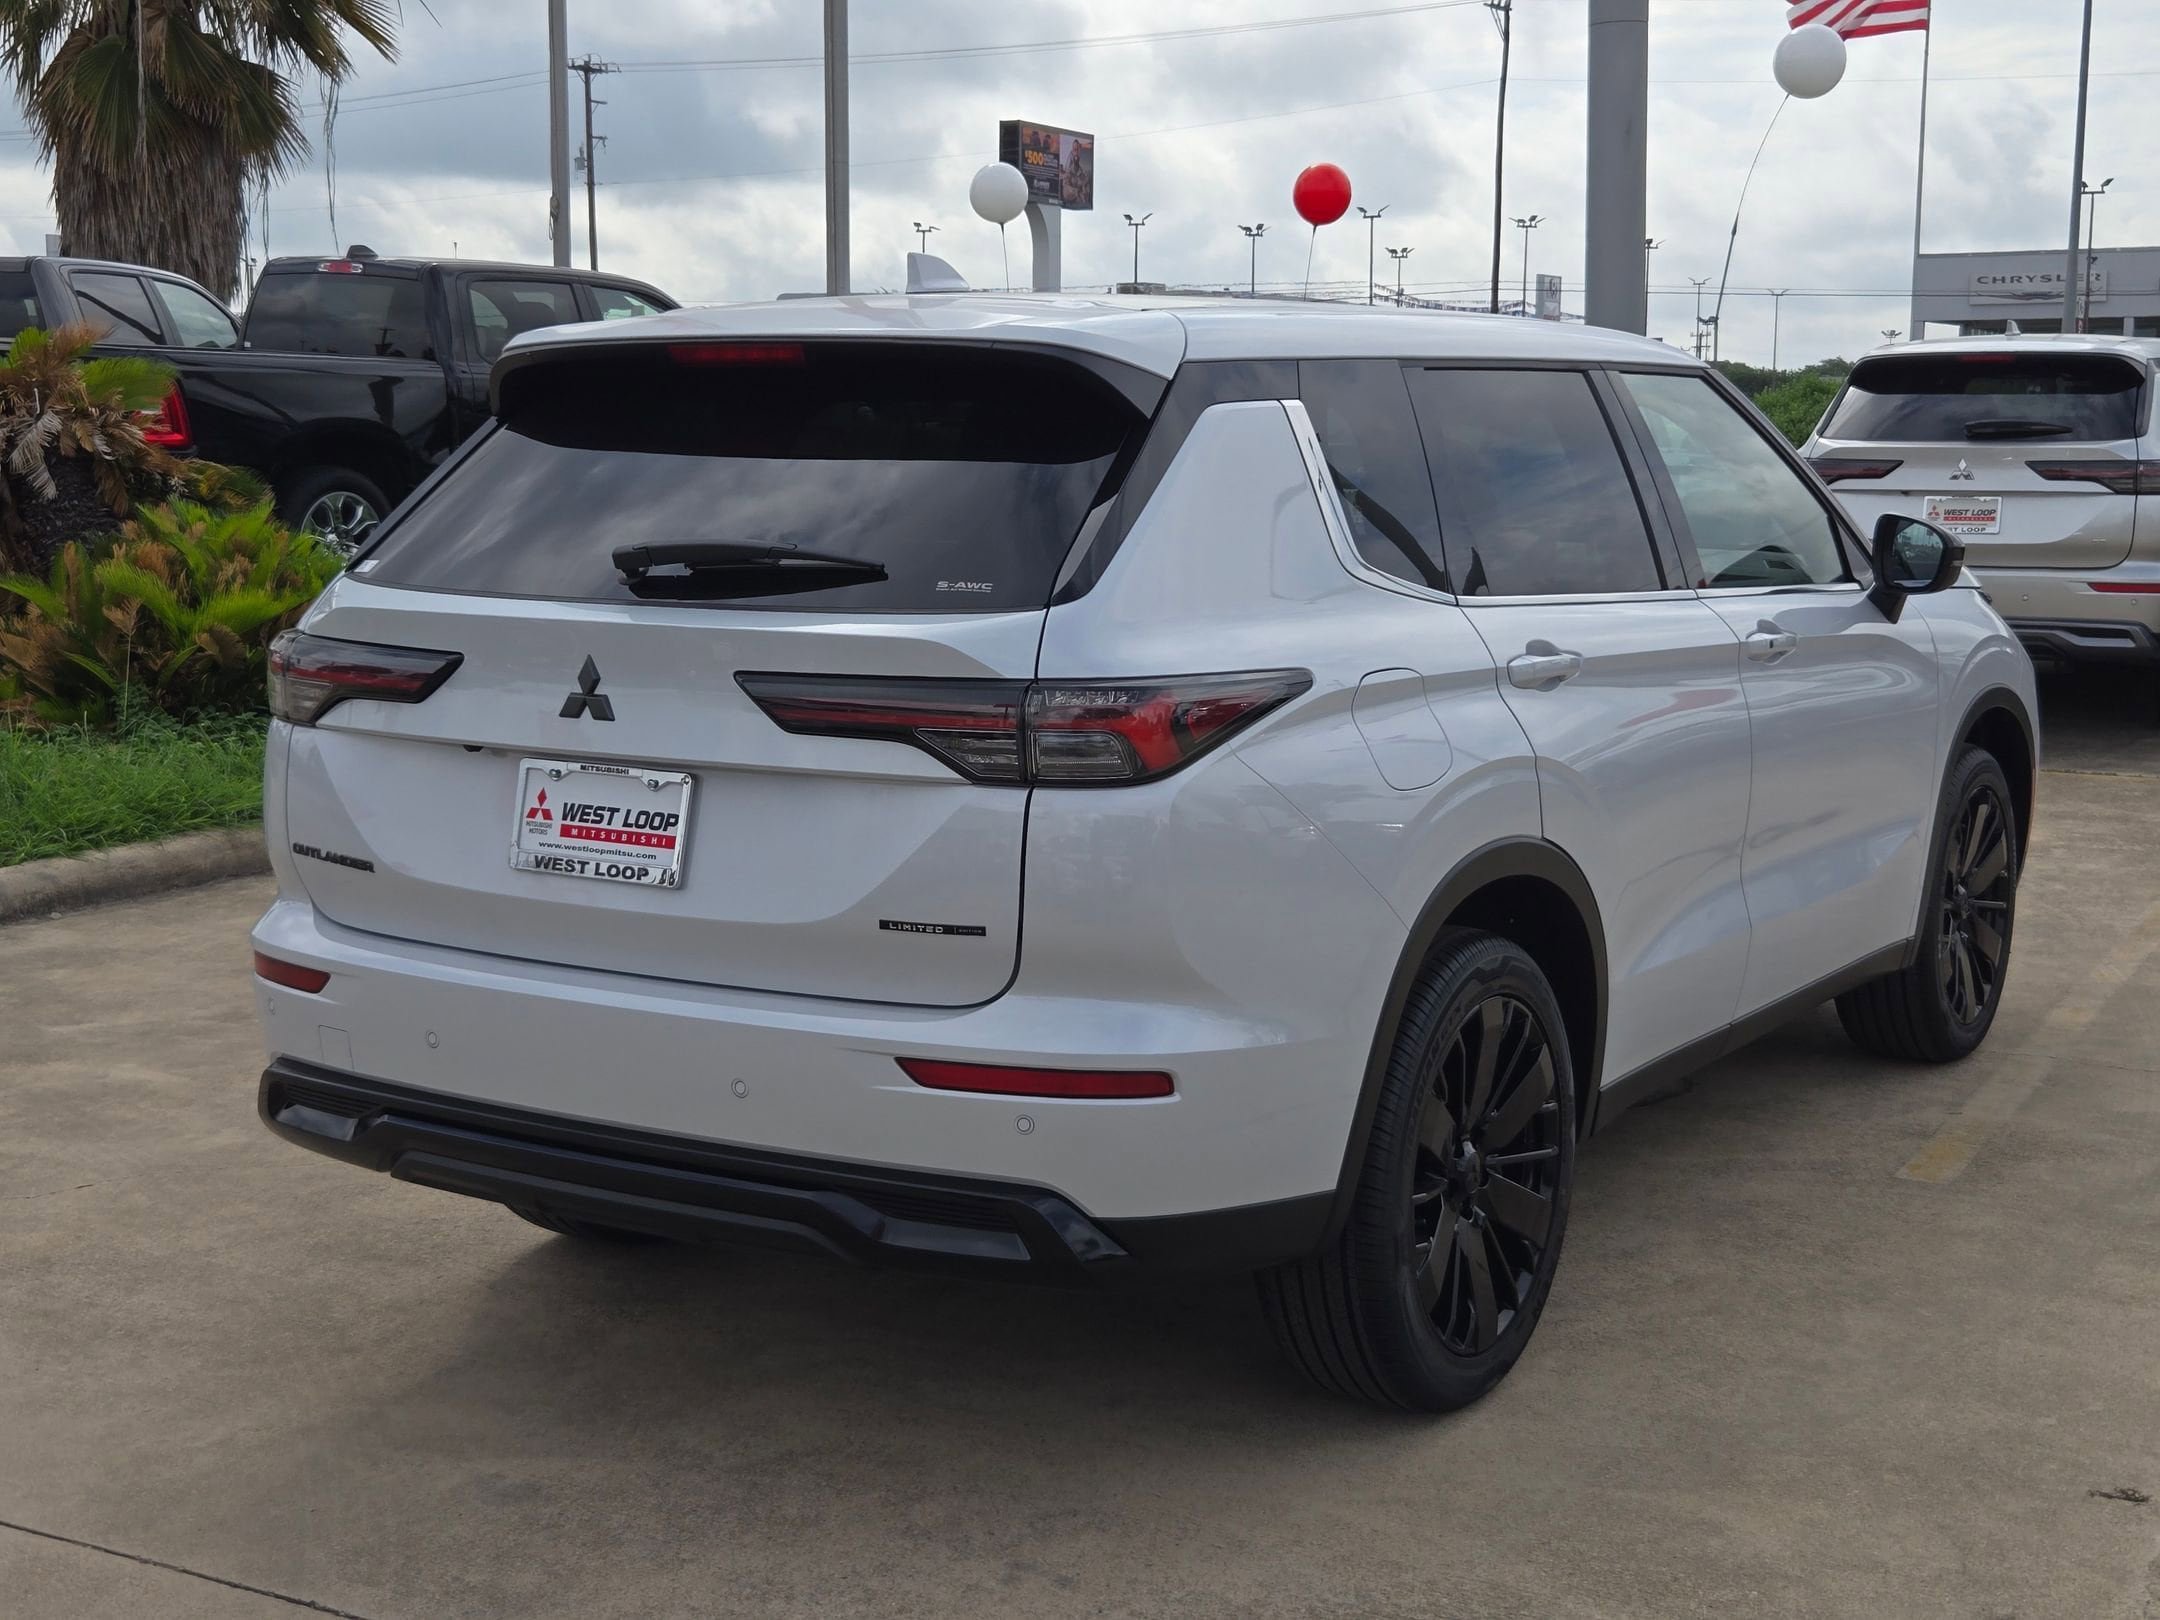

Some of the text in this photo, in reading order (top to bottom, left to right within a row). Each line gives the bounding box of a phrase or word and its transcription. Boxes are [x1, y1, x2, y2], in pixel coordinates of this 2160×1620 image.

[1971, 509, 1996, 517] LOOP
[936, 581, 993, 590] S-AWC
[580, 764, 630, 776] MITSUBISHI
[562, 802, 680, 832] WEST LOOP
[571, 828, 666, 846] MITSUBISHI
[538, 841, 657, 860] www.westloopmitsu.com
[534, 855, 650, 881] WEST LOOP
[888, 921, 944, 934] LIMITED
